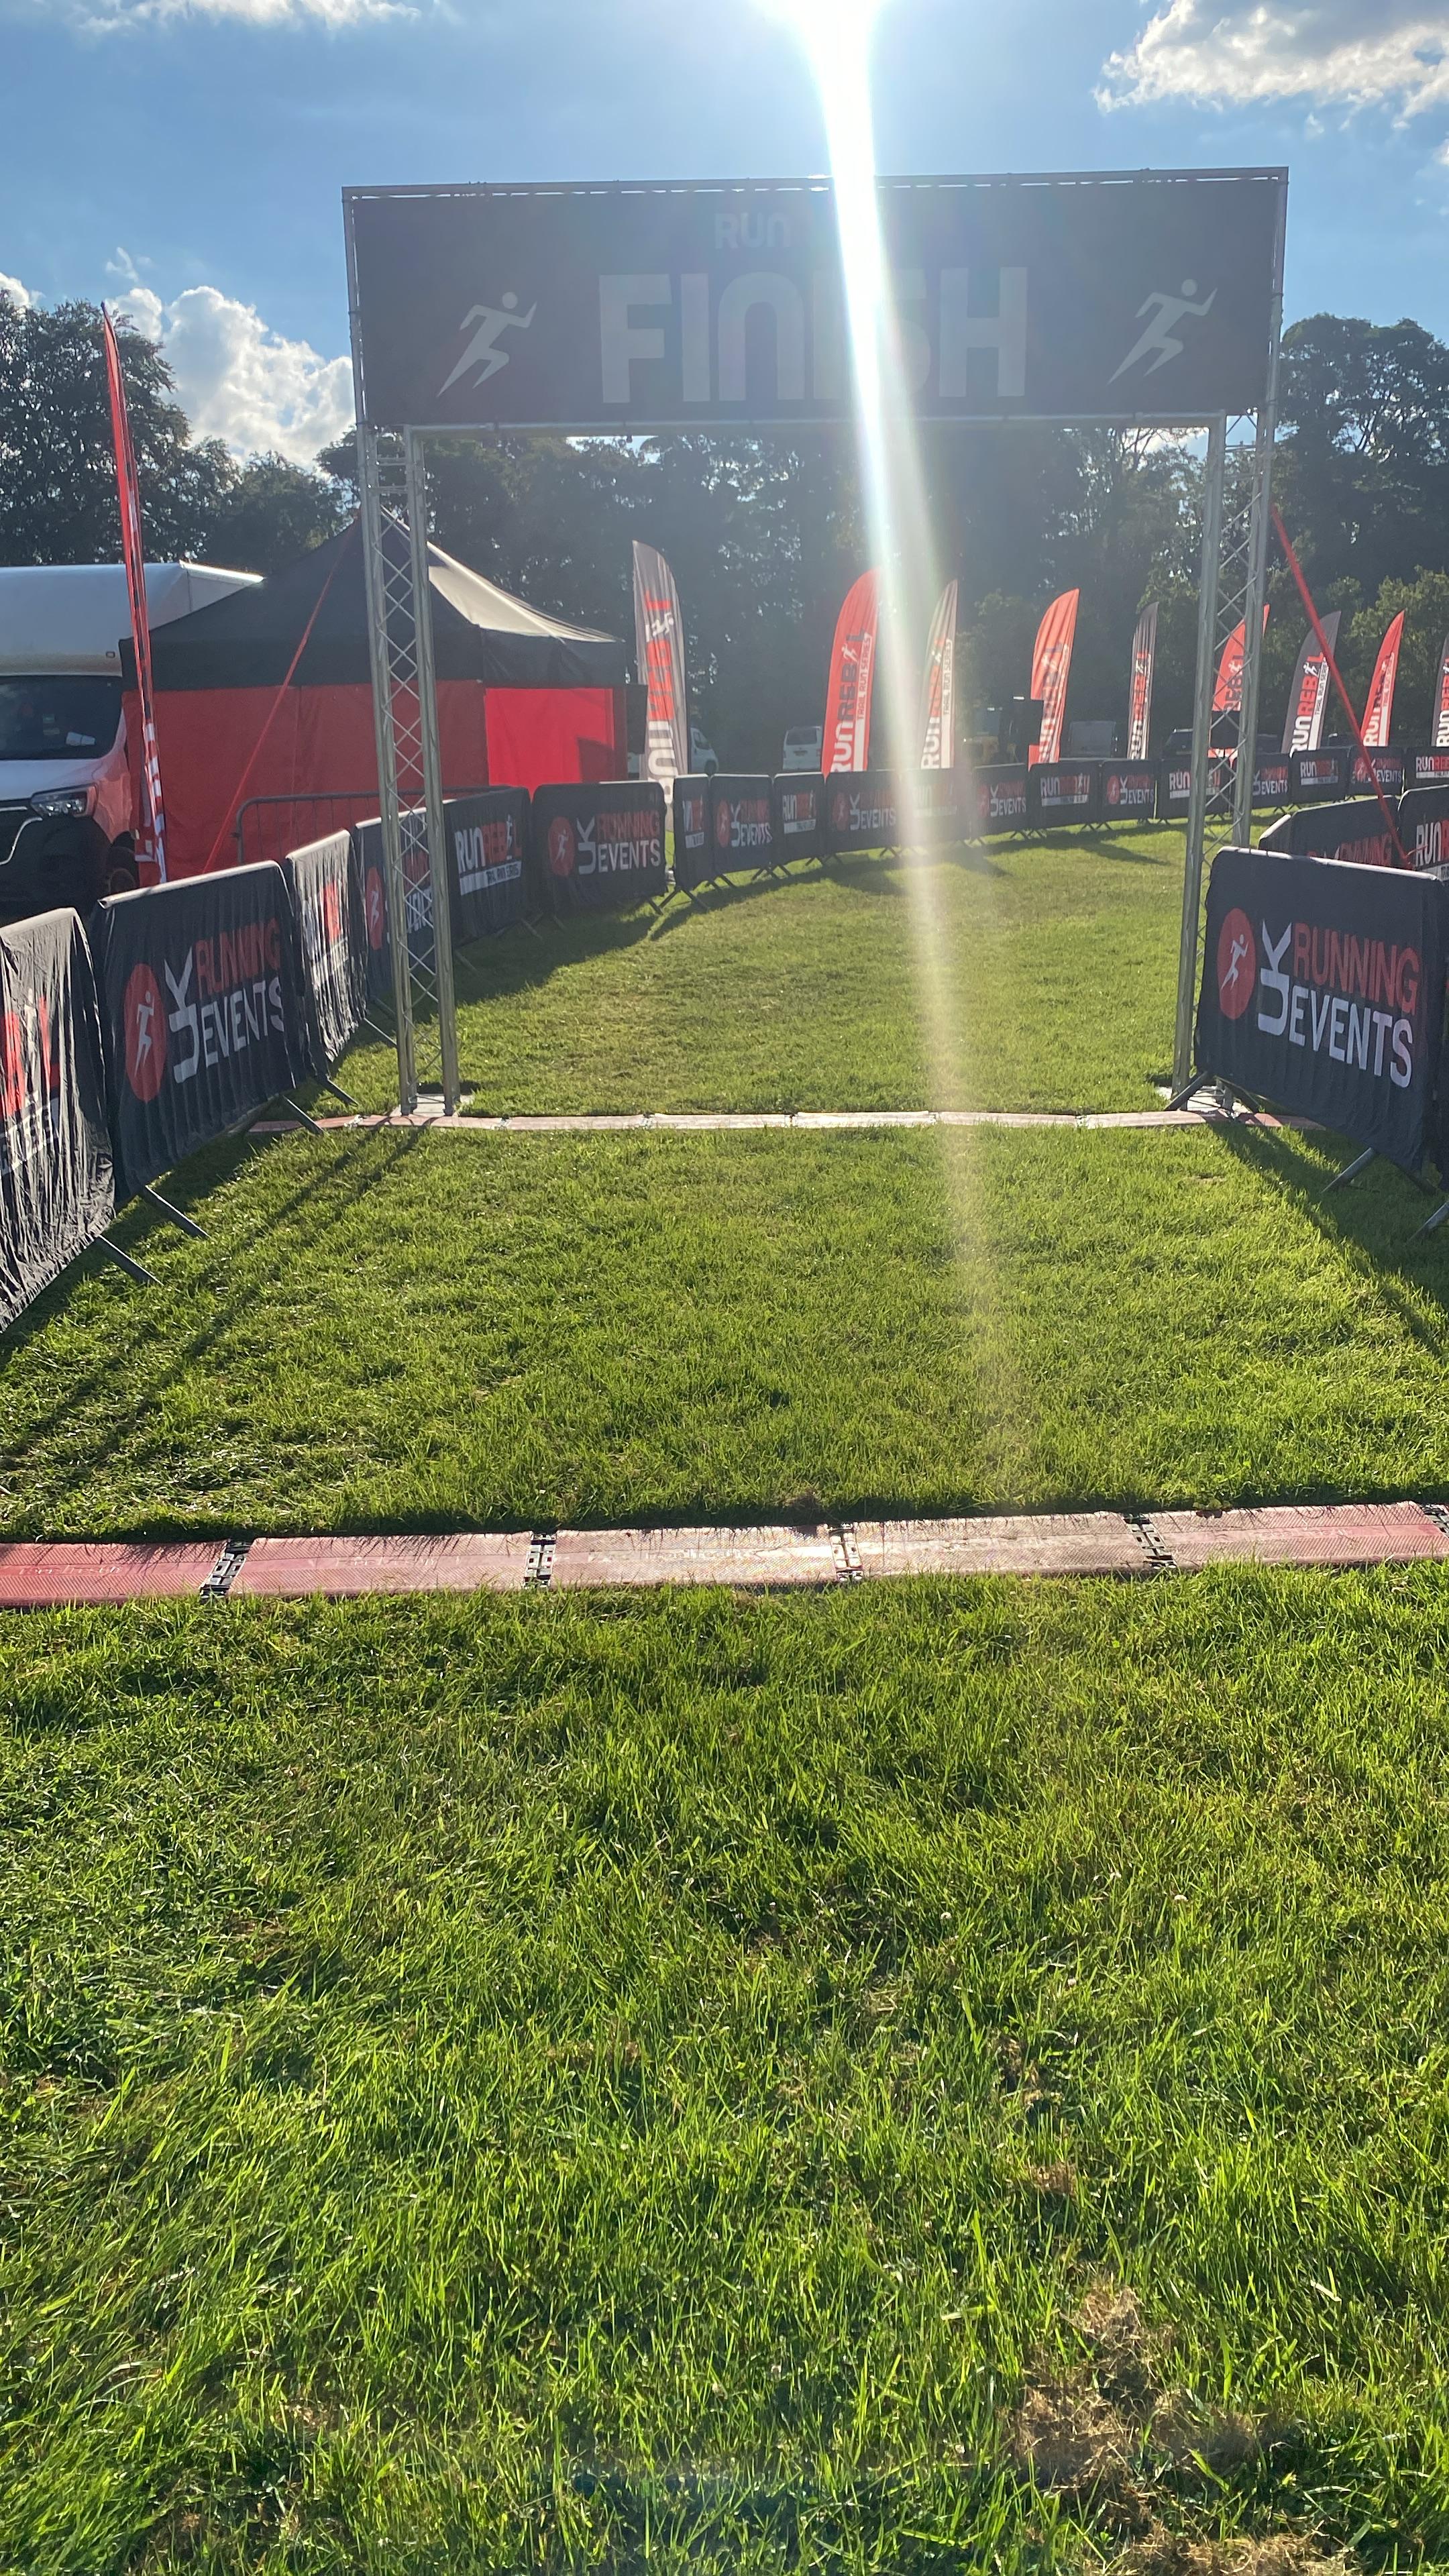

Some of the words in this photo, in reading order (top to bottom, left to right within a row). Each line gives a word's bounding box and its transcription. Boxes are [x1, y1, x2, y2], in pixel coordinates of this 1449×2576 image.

[599, 267, 1028, 404] FINISH
[598, 839, 661, 873] EVENTS
[1293, 922, 1420, 1016] RUNNING
[201, 976, 284, 1069] EVENTS
[1289, 985, 1413, 1088] EVENTS
